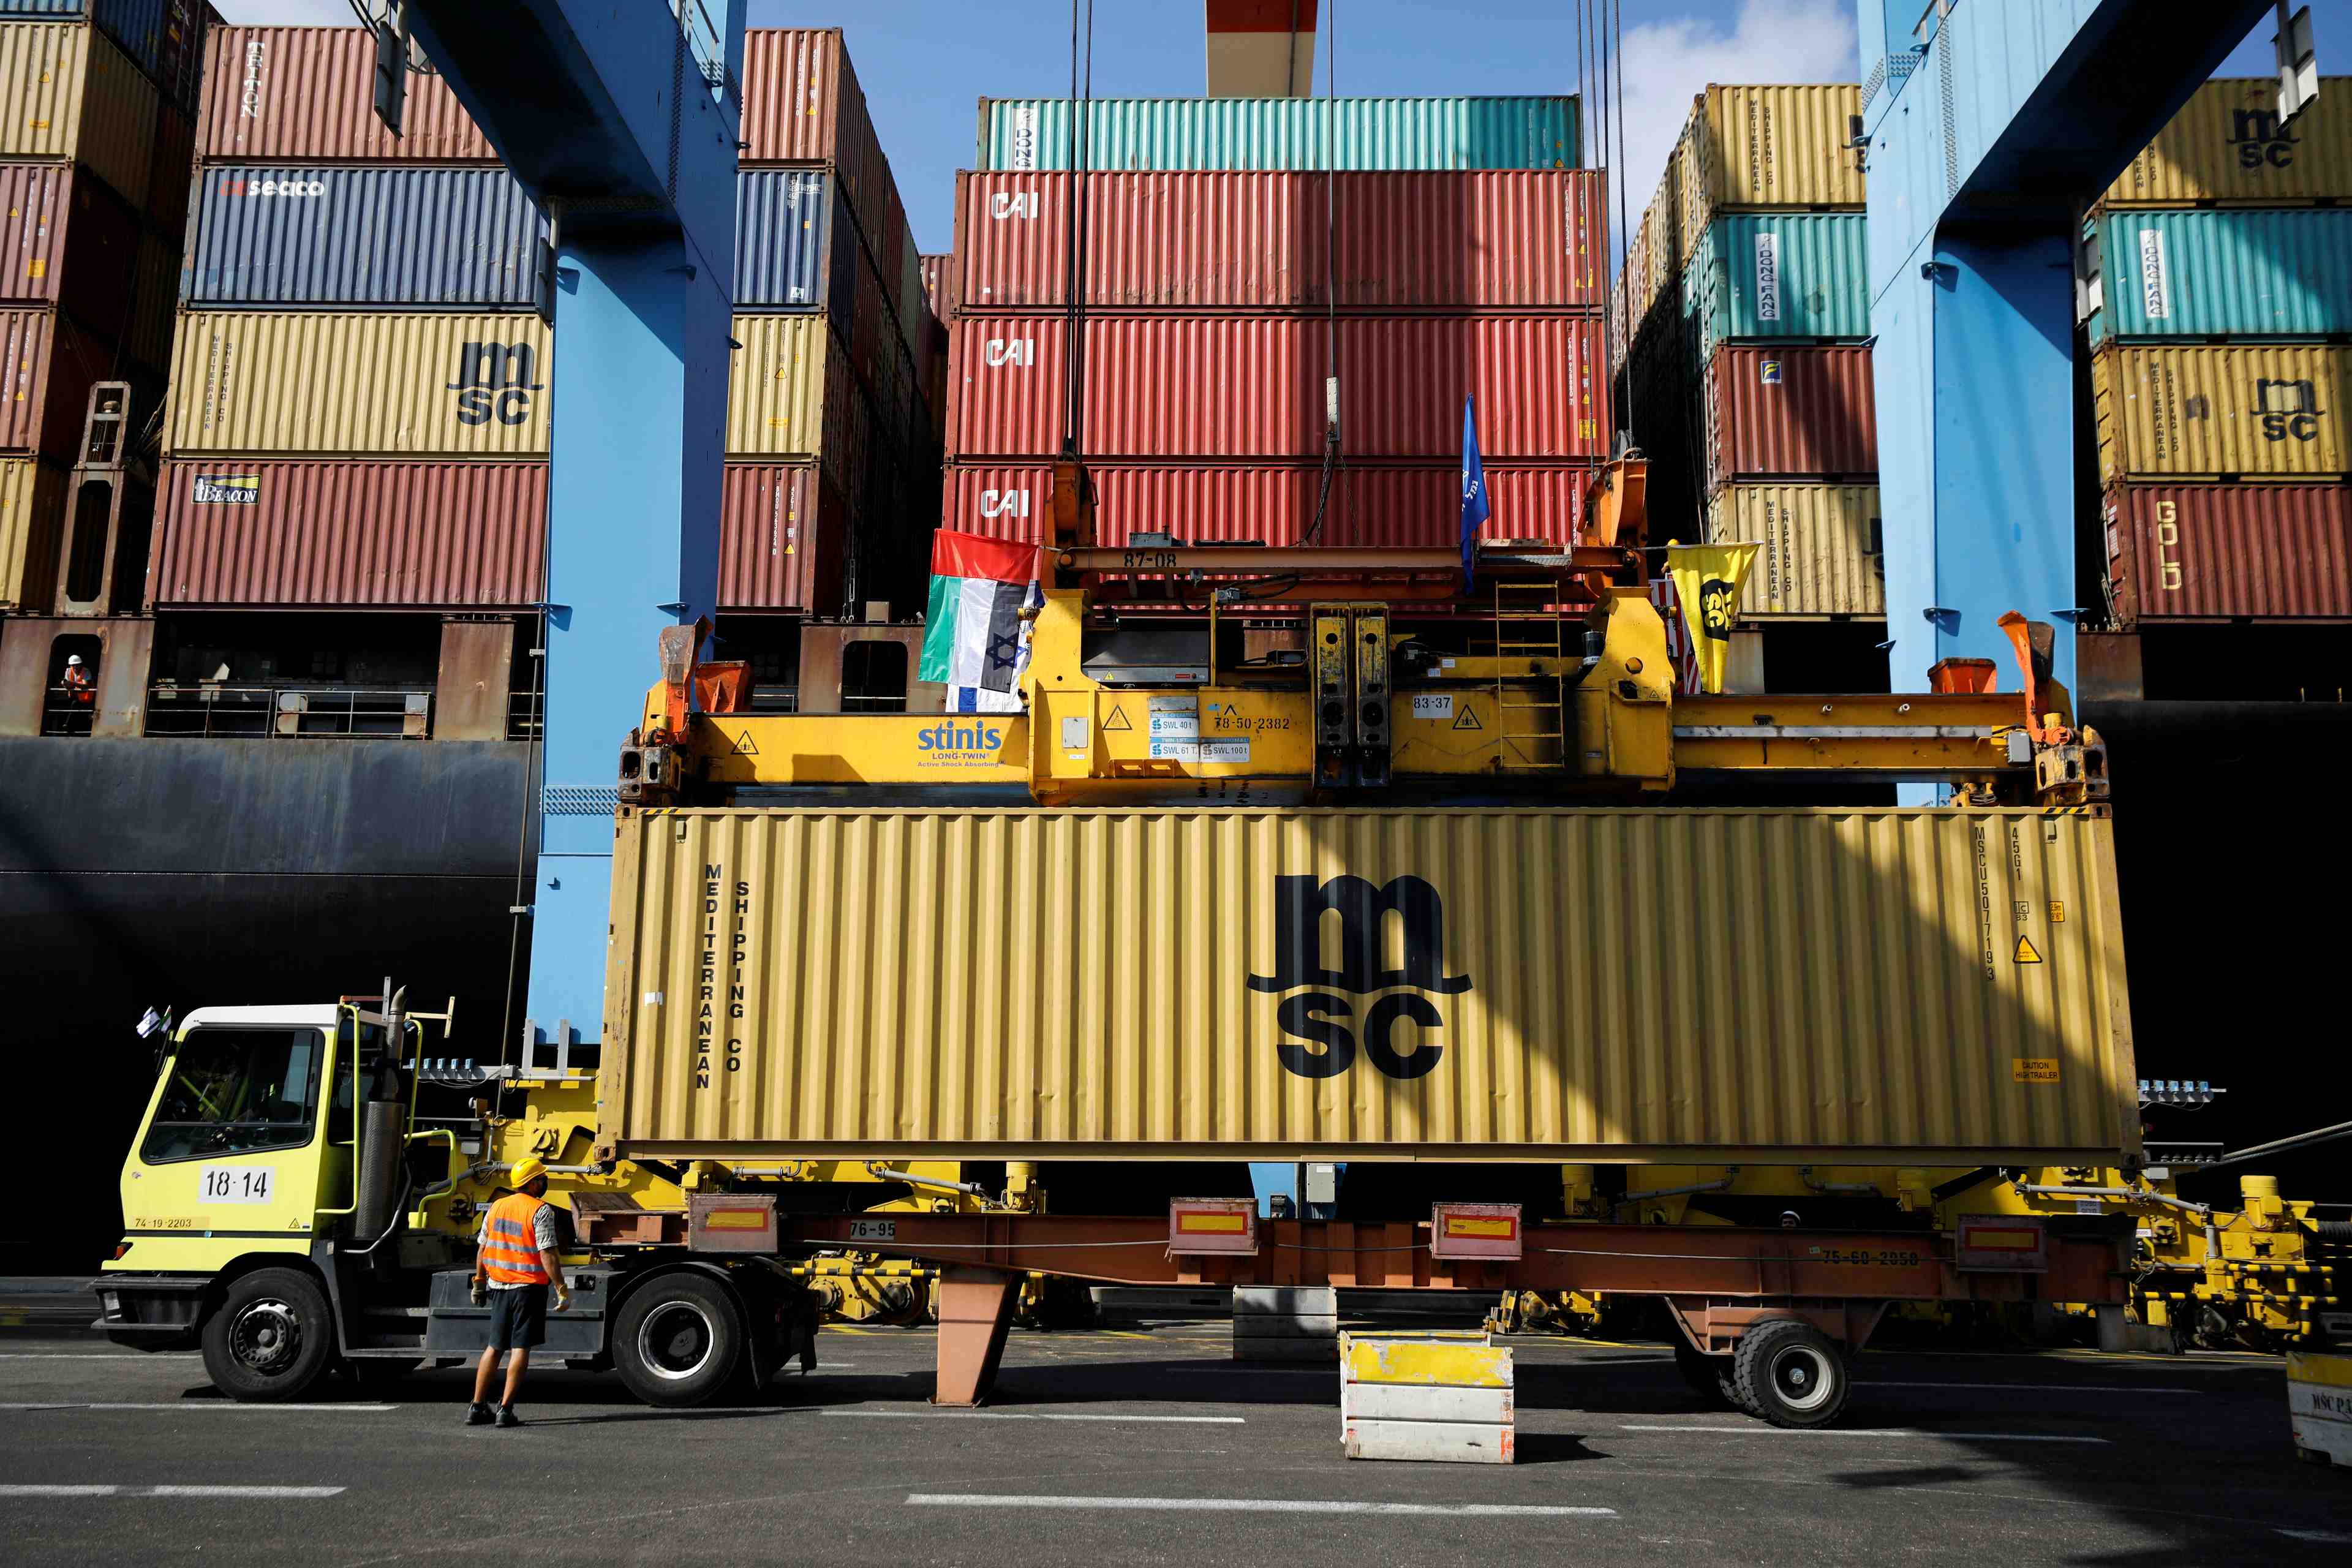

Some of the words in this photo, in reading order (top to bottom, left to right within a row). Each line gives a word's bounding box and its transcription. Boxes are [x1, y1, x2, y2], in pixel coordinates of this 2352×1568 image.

[241, 41, 265, 118] TRITON
[1749, 100, 1760, 192] MEDITERRANEAN
[1766, 171, 1773, 184] CO
[991, 191, 1038, 220] CAI
[1759, 249, 1774, 282] DONG
[1761, 285, 1775, 318] FANG
[986, 338, 1035, 366] CAI
[205, 334, 220, 429] MEDITERRANEAN
[221, 342, 232, 400] SHIPPING
[217, 408, 225, 422] CO
[2150, 362, 2166, 459] MEDITERRANEAN
[2165, 369, 2177, 432] SHIPPING
[2171, 435, 2179, 453] CO
[203, 484, 257, 502] BEACON
[981, 488, 1030, 518] CAI
[1766, 501, 1779, 599] MEDITERRANEAN
[1781, 508, 1791, 568] SHIPPING
[2156, 500, 2182, 590] GOLD
[1784, 577, 1792, 592] CO
[1414, 697, 1450, 709] 83-37
[918, 720, 1002, 750] stinis
[1163, 721, 1178, 729] SWL
[1180, 721, 1188, 729] 40
[1163, 746, 1179, 755] SWL
[1180, 746, 1189, 755] 61
[2011, 827, 2021, 881] 45G1
[729, 881, 749, 1019] SHIPPING
[696, 863, 722, 1089] MEDITERRANEAN
[726, 1038, 741, 1072] CO
[135, 1218, 192, 1228] 74-19-2203
[851, 1223, 896, 1236] 76-95
